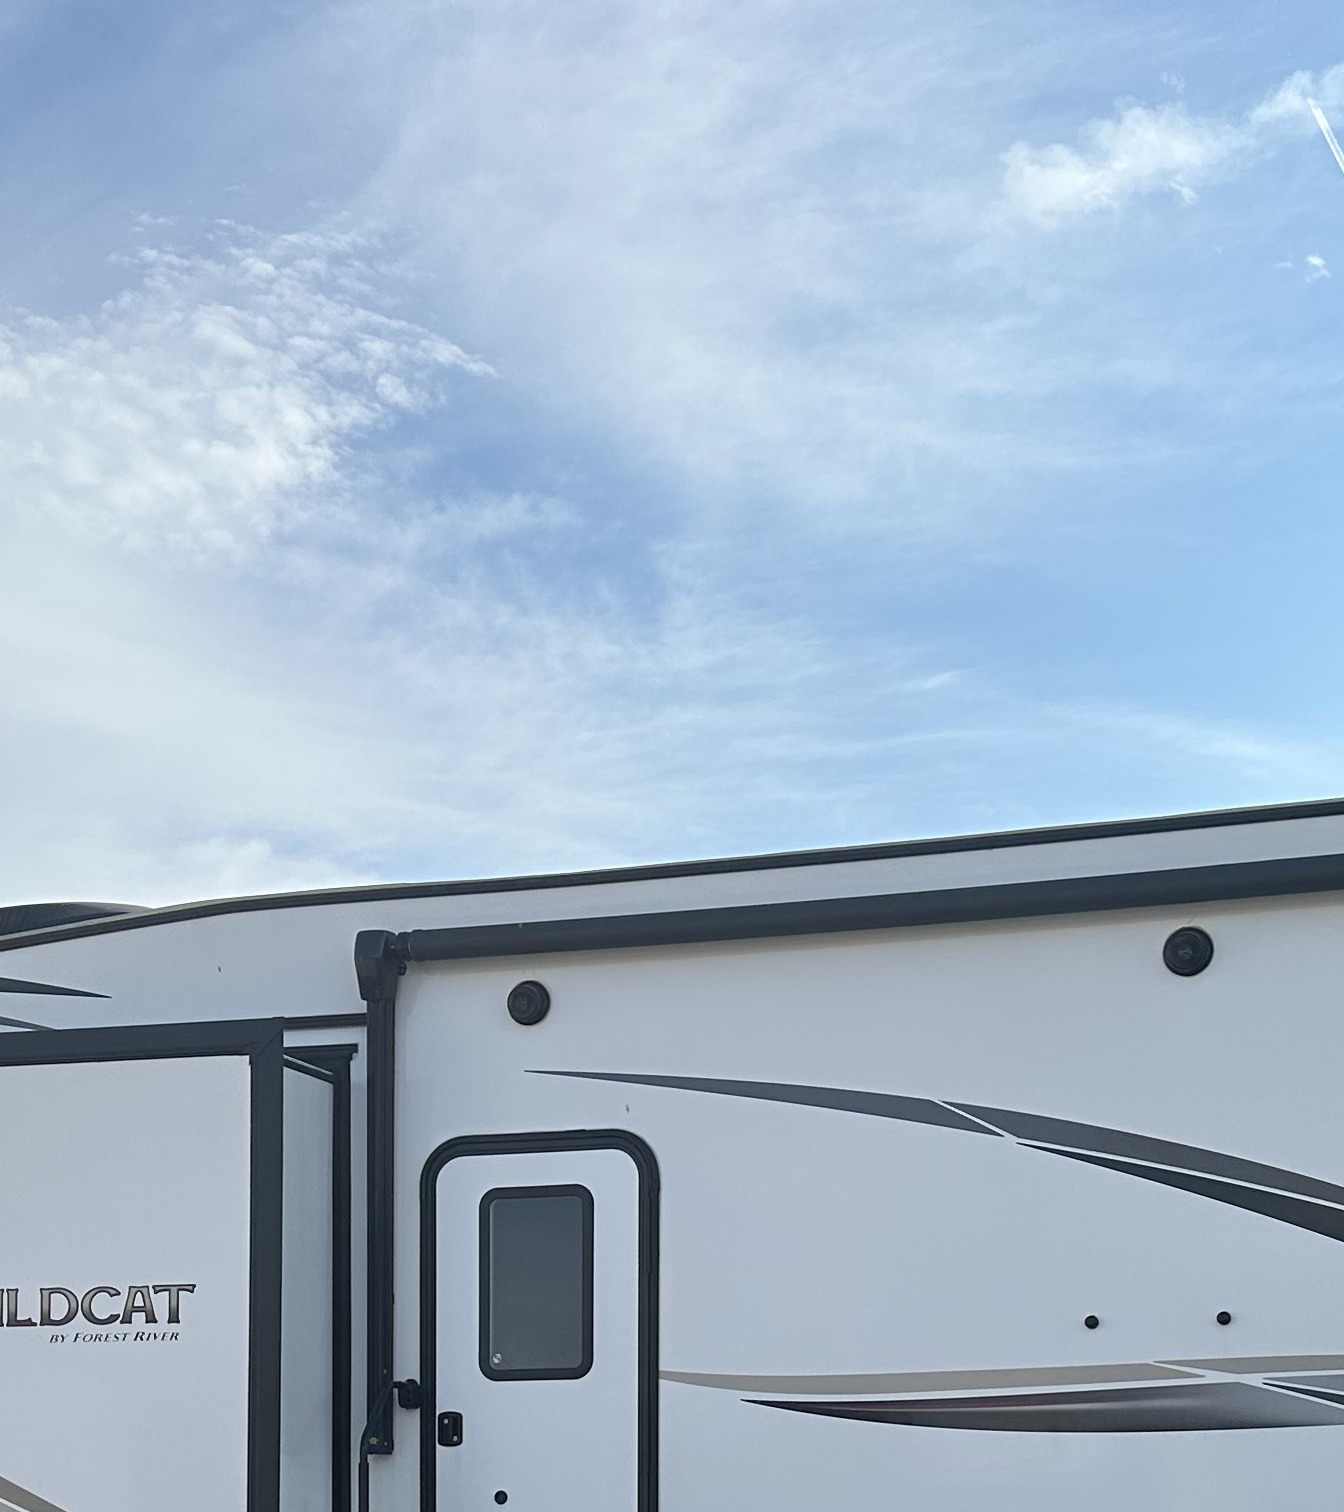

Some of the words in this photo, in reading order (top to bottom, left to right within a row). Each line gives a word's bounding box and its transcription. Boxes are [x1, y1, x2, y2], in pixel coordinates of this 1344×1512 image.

[49, 1333, 69, 1344] BY
[73, 1331, 131, 1343] FOREST
[133, 1331, 180, 1342] RIVER
